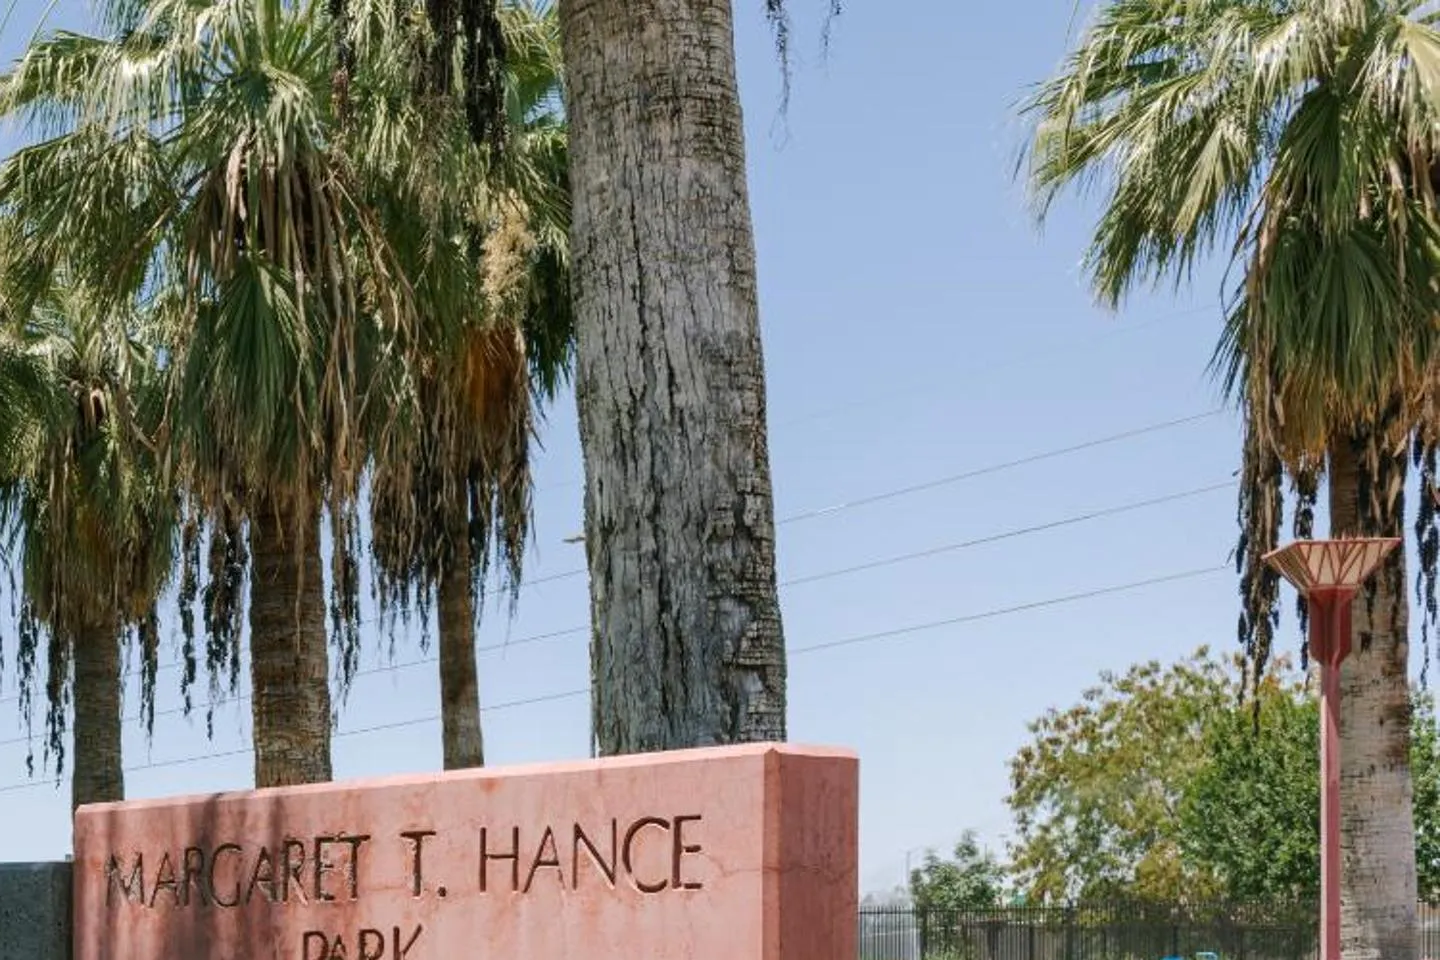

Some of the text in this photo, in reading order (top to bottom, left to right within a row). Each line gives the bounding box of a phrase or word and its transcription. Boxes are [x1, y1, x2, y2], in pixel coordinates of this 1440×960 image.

[106, 814, 703, 908] MARGARET T. HANCE
